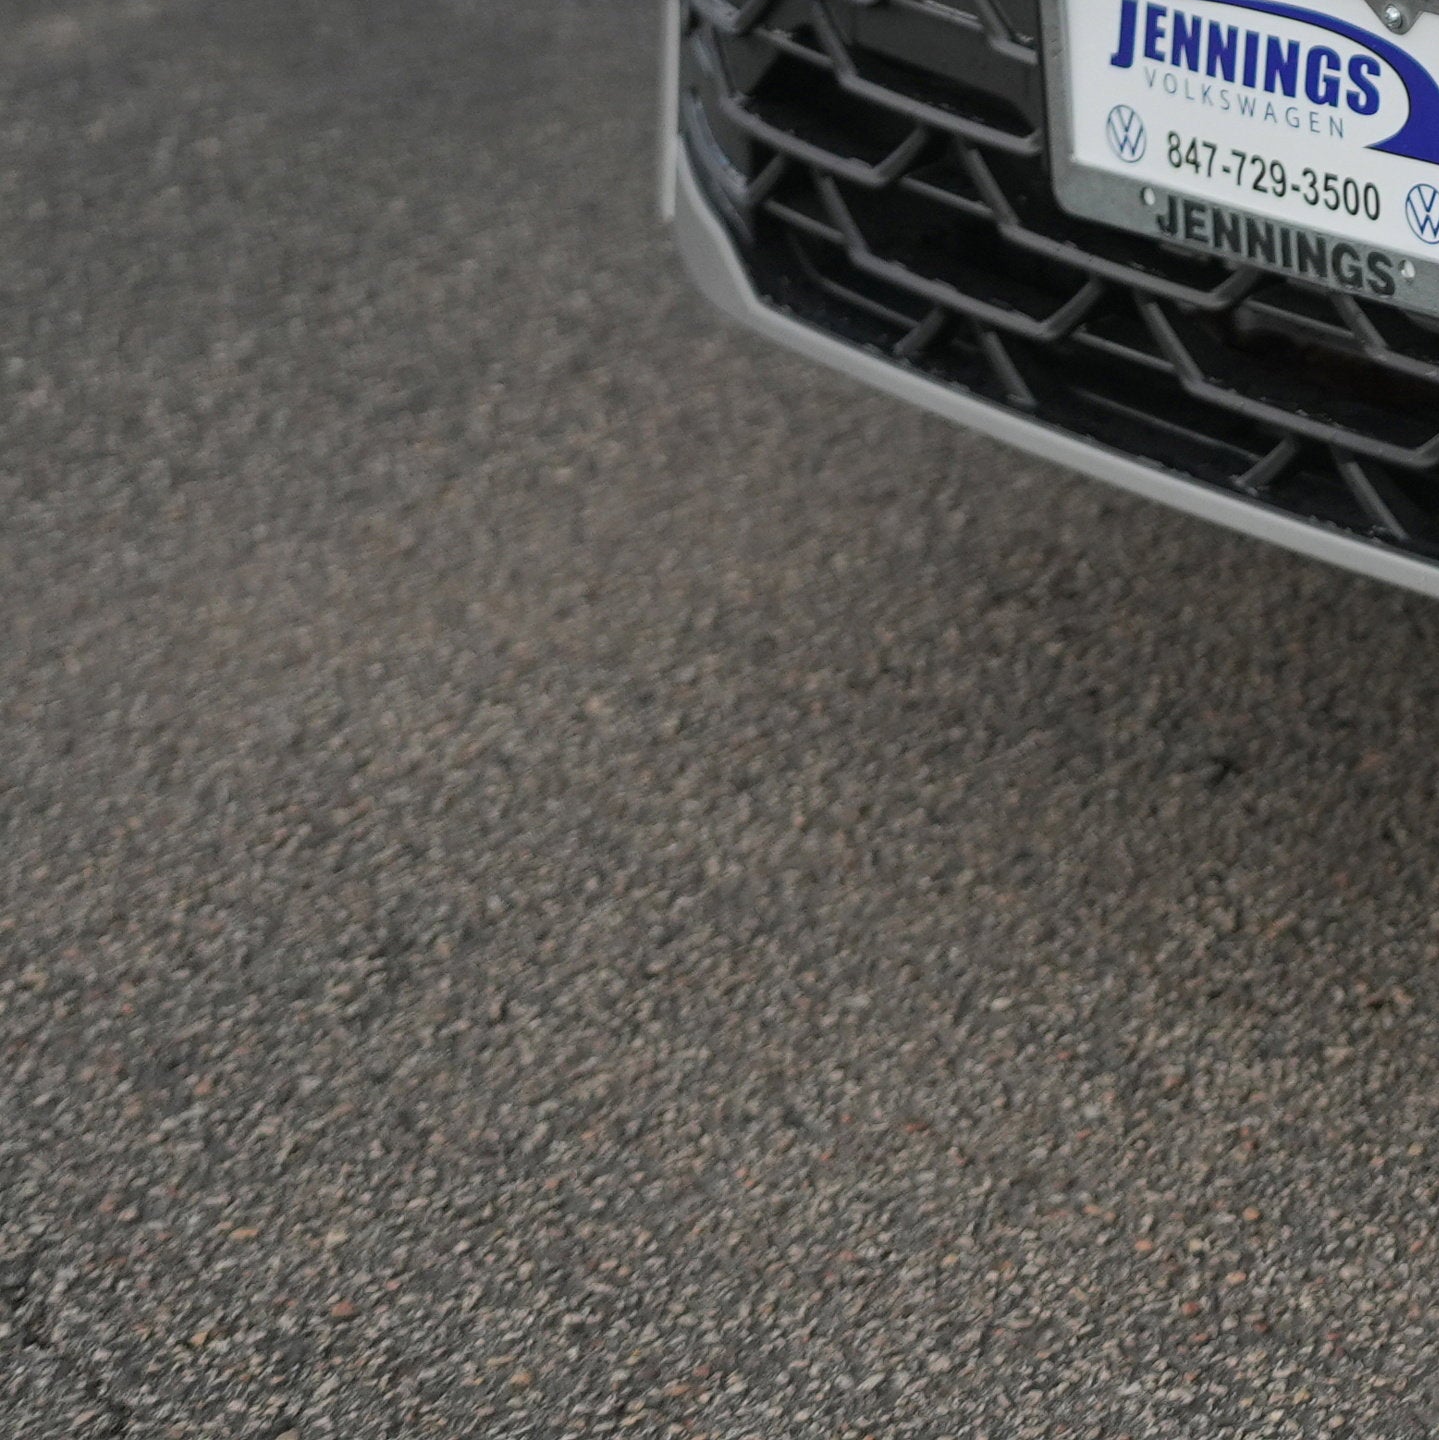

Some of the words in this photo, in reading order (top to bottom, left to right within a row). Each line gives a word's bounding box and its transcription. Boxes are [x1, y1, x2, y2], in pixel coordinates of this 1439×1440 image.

[1106, 104, 1147, 163] VW
[1144, 66, 1345, 139] VOLKSWAGEN
[1167, 131, 1380, 221] 847-729-3500
[1156, 195, 1396, 296] JENNINGS
